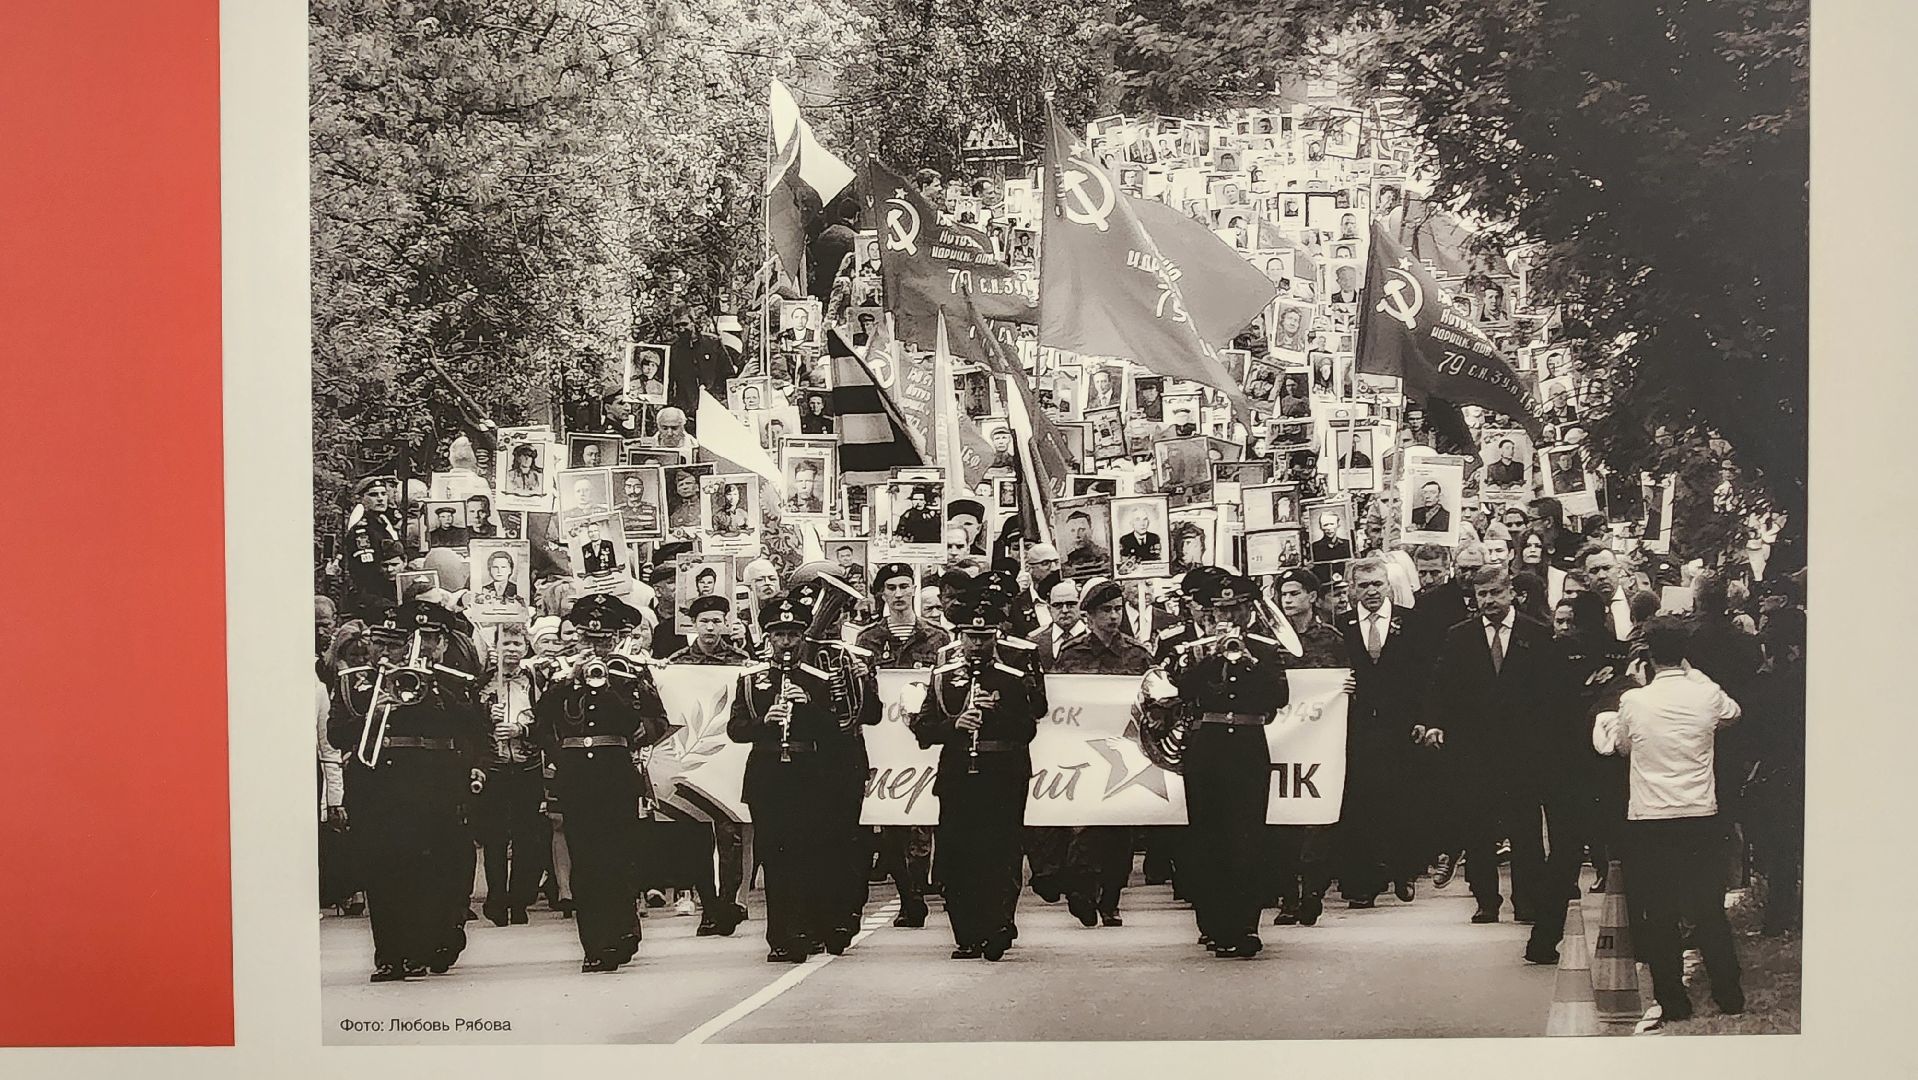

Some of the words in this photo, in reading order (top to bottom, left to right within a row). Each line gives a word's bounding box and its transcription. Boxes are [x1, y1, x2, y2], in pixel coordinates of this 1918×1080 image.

[1438, 351, 1466, 375] 79
[340, 1018, 384, 1032] Фото:
[388, 1018, 450, 1032] Любовь
[455, 1018, 512, 1032] Рябова
